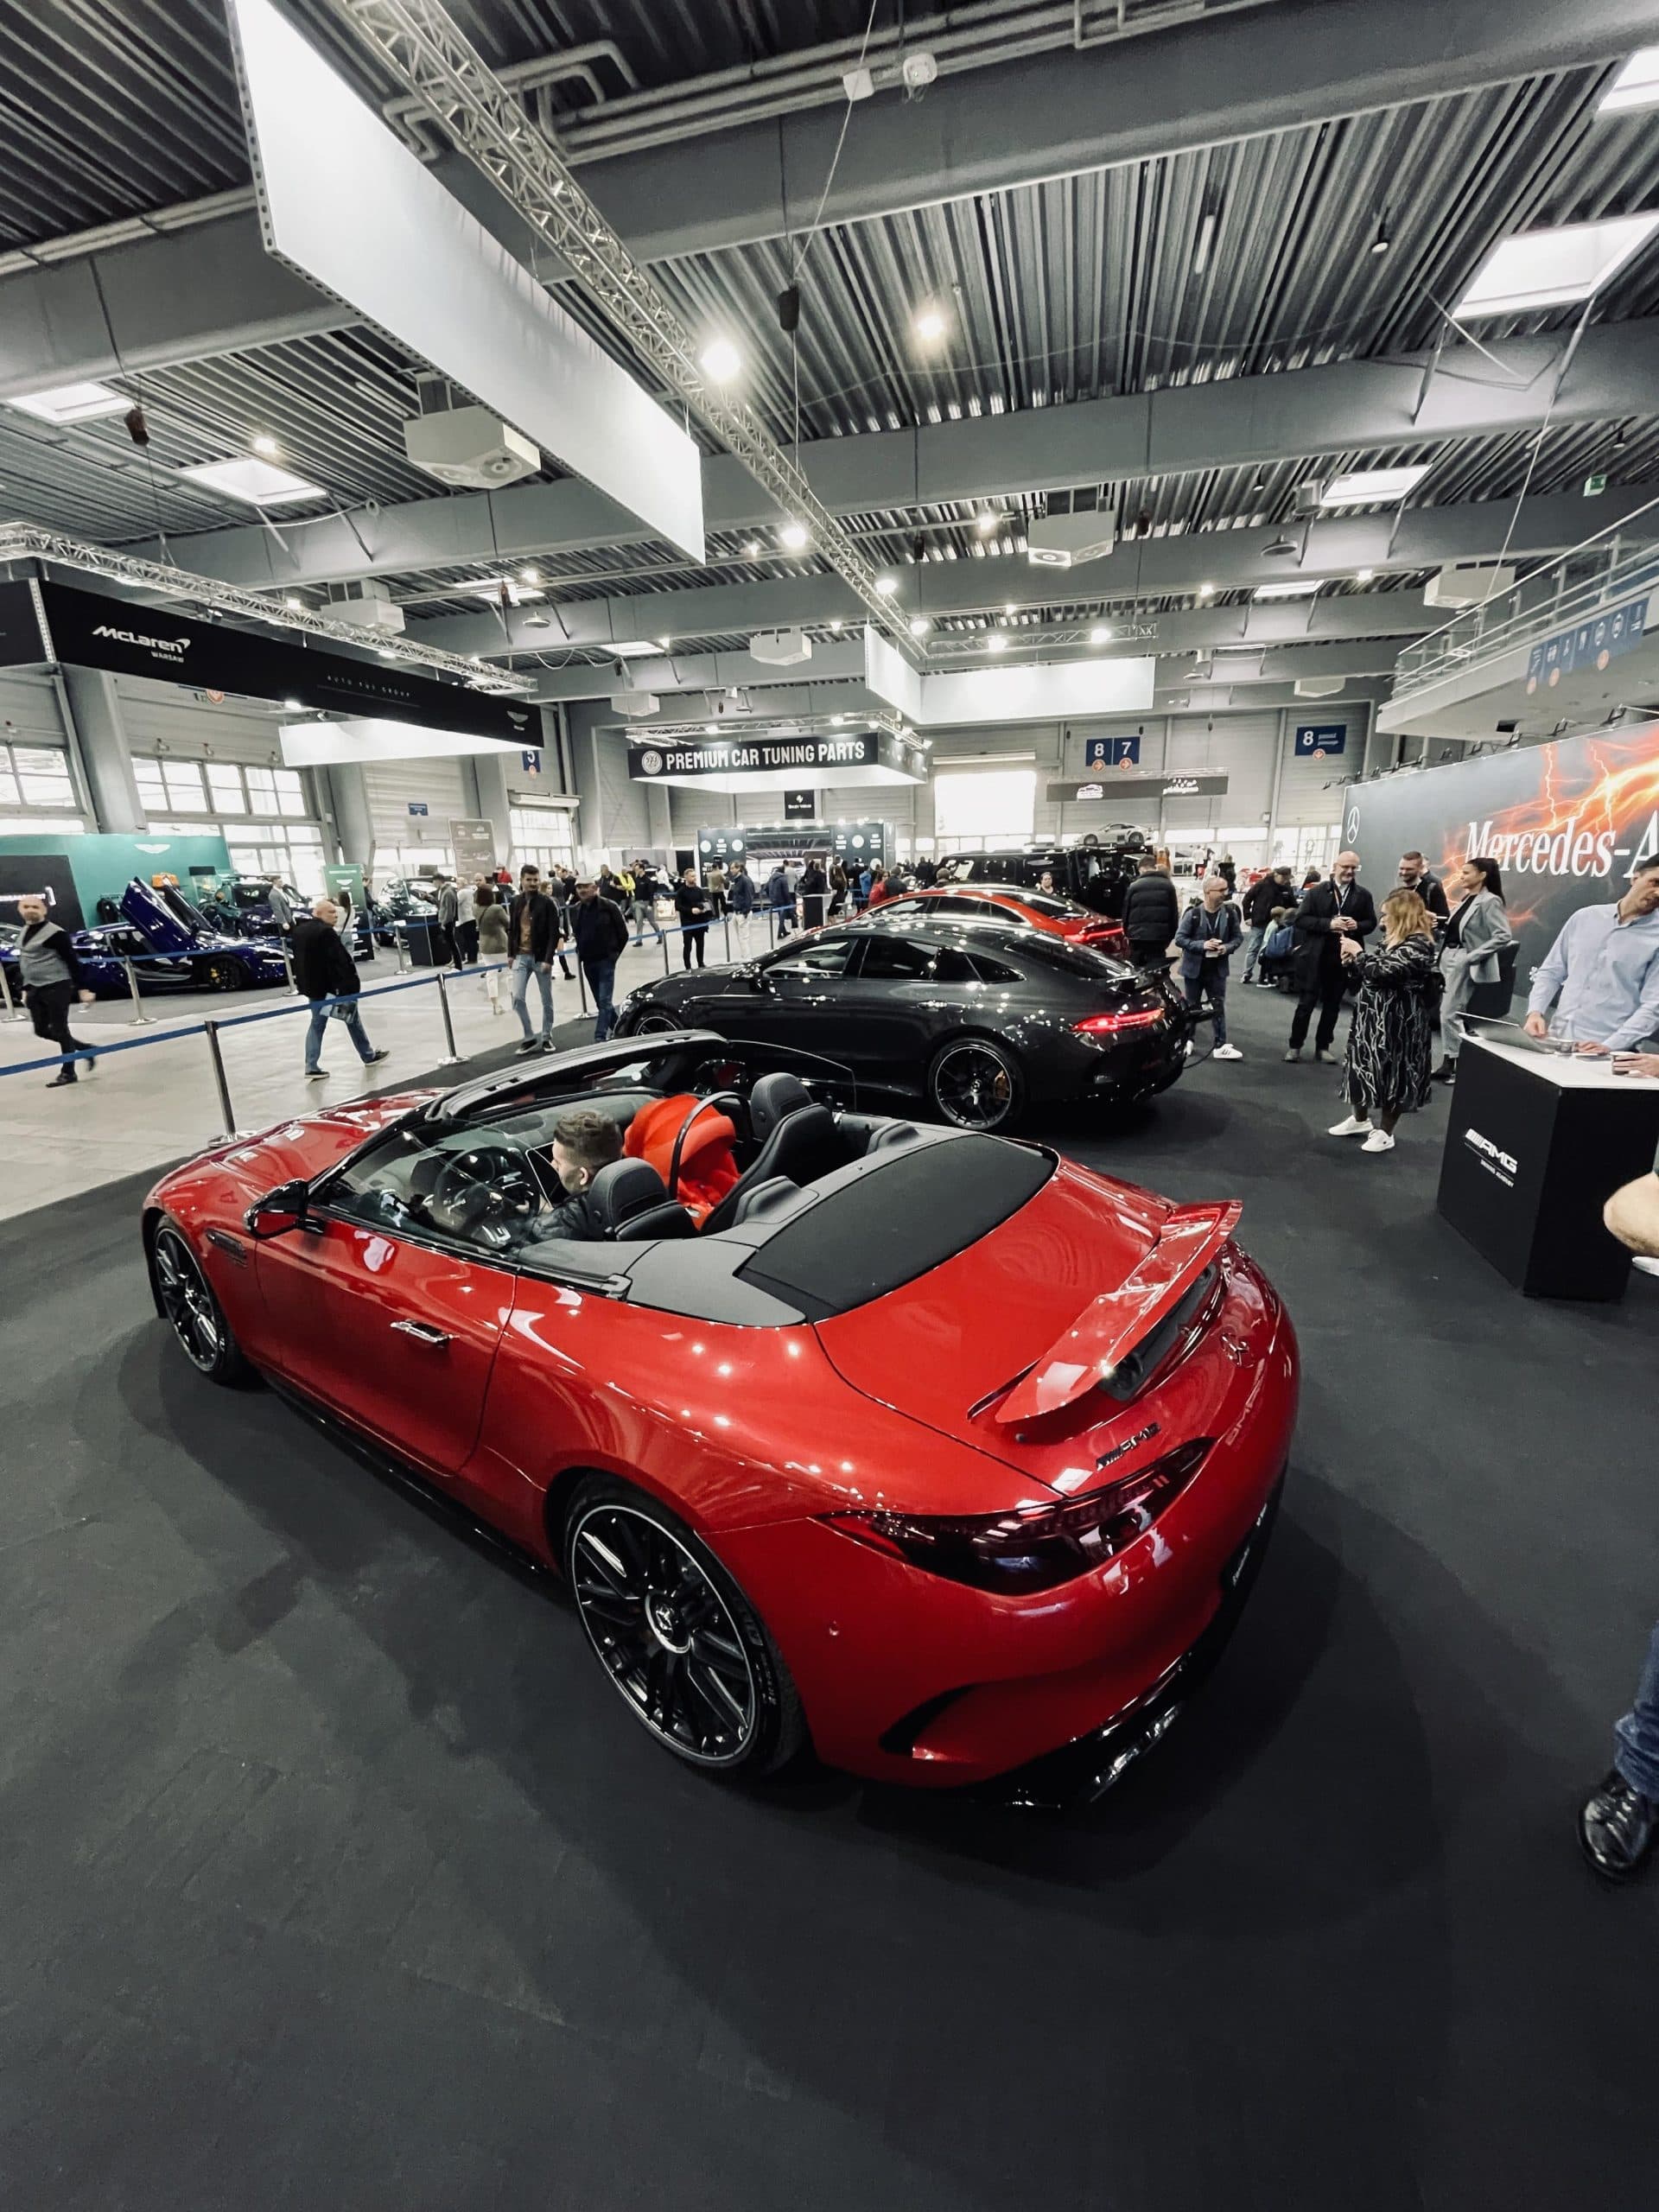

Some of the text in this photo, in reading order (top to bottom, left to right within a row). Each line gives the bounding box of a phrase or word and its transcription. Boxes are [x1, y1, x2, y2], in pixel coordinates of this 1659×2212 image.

[92, 626, 183, 653] McLaren
[1122, 741, 1132, 755] 7
[1303, 731, 1313, 746] 8
[666, 749, 728, 770] PREMIUM
[731, 748, 760, 766] CAR
[762, 745, 815, 765] TUNING
[818, 741, 865, 761] PARTS
[1095, 743, 1104, 757] 8
[1478, 1138, 1518, 1174] AMG
